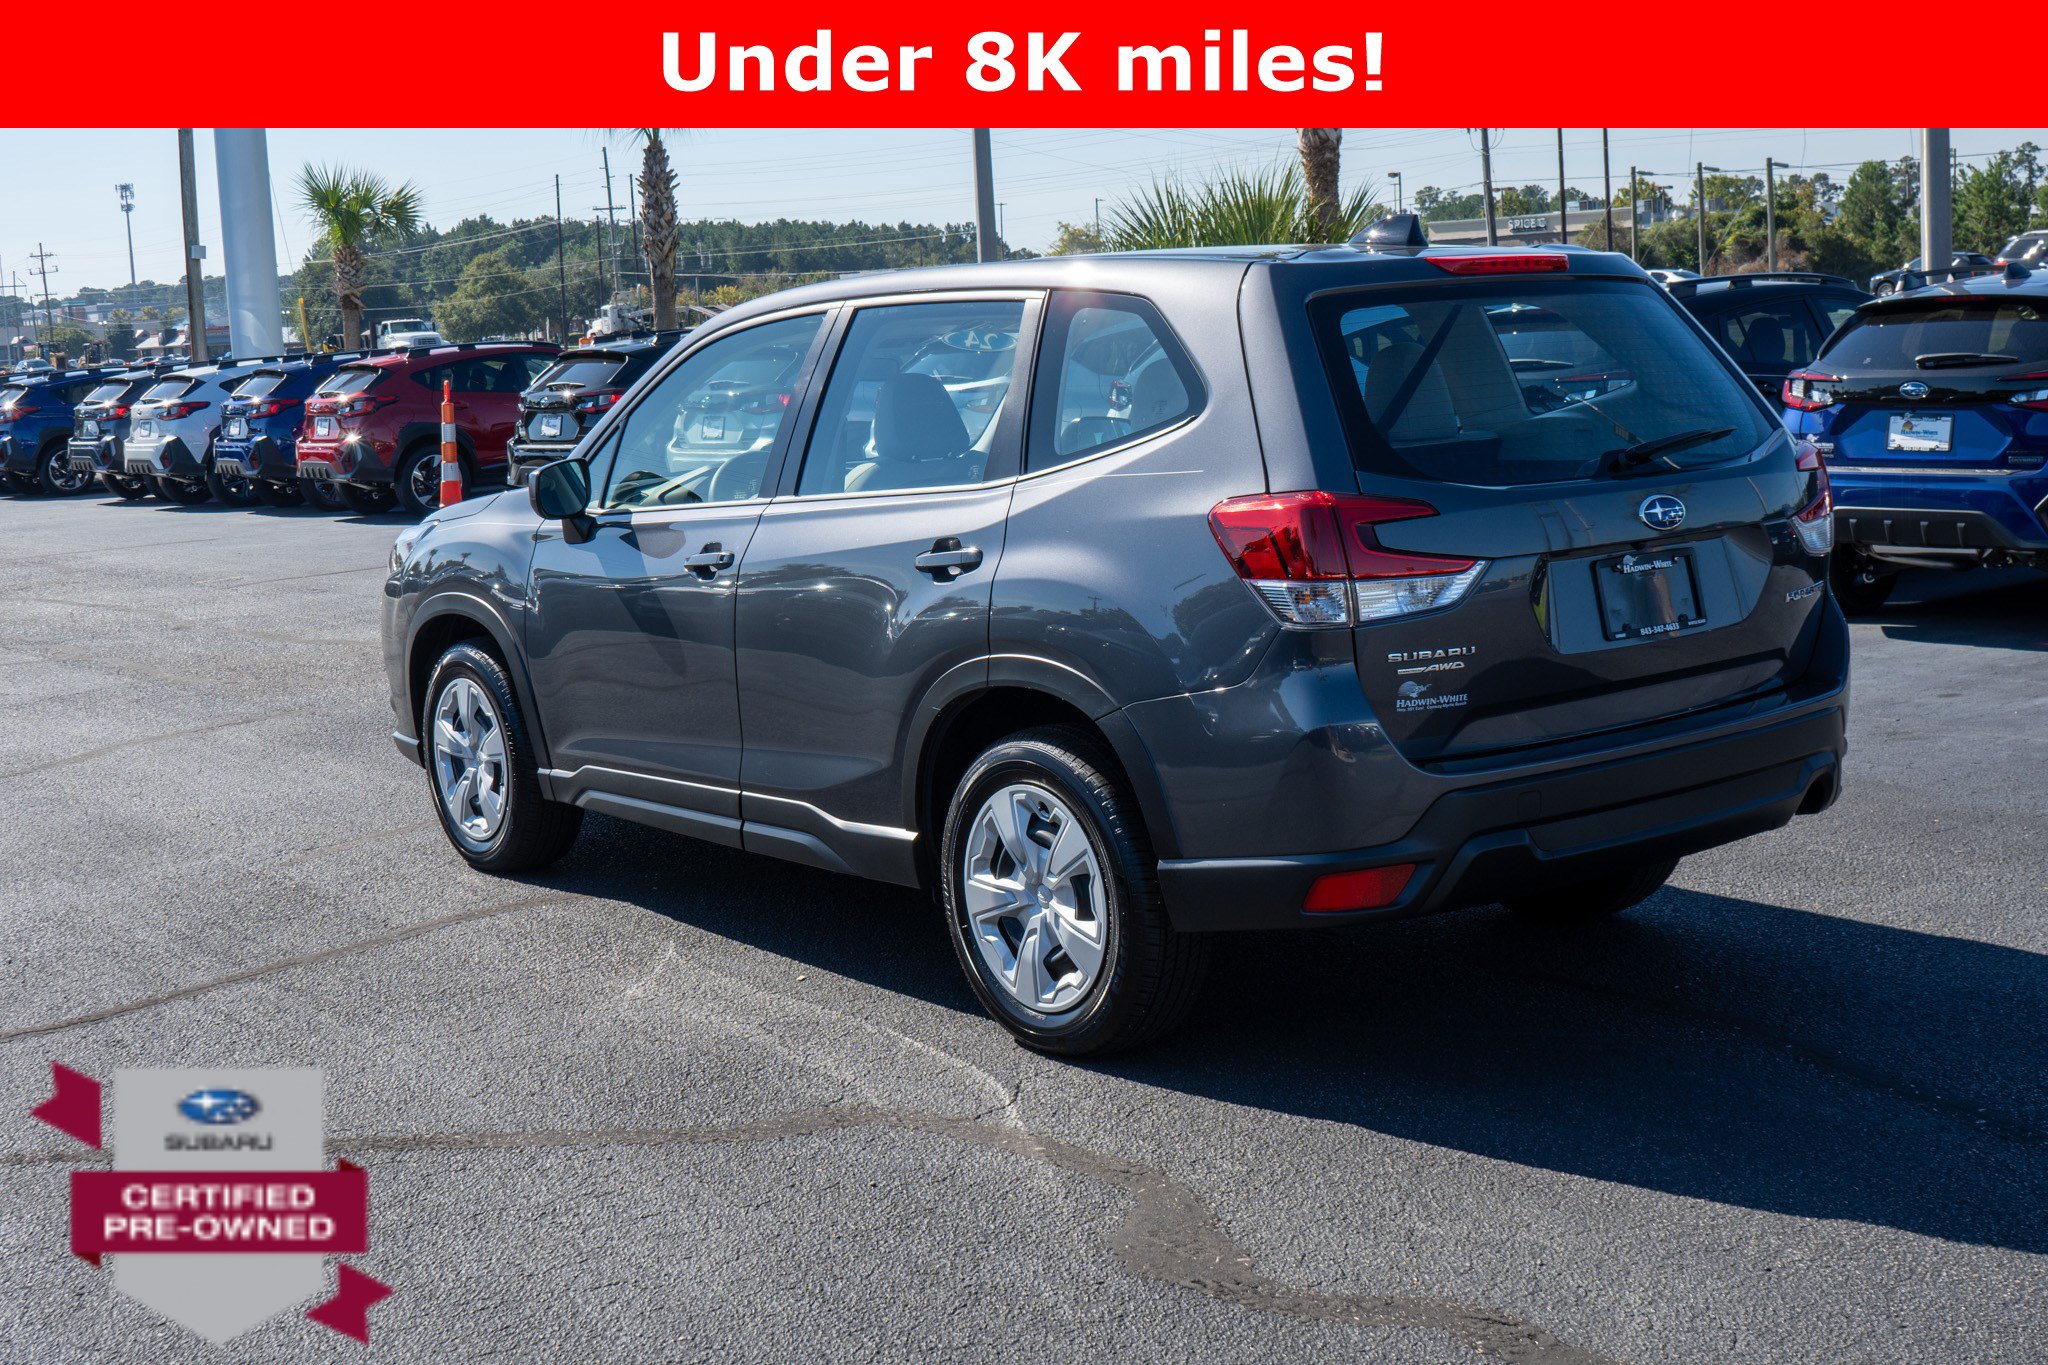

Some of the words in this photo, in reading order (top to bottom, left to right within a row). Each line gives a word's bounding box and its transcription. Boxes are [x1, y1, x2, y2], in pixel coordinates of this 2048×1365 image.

[1508, 218, 1536, 230] SPICE
[1387, 646, 1476, 662] SUBARU
[1424, 661, 1465, 673] AWD
[1396, 694, 1468, 708] HADWIN-WHITE
